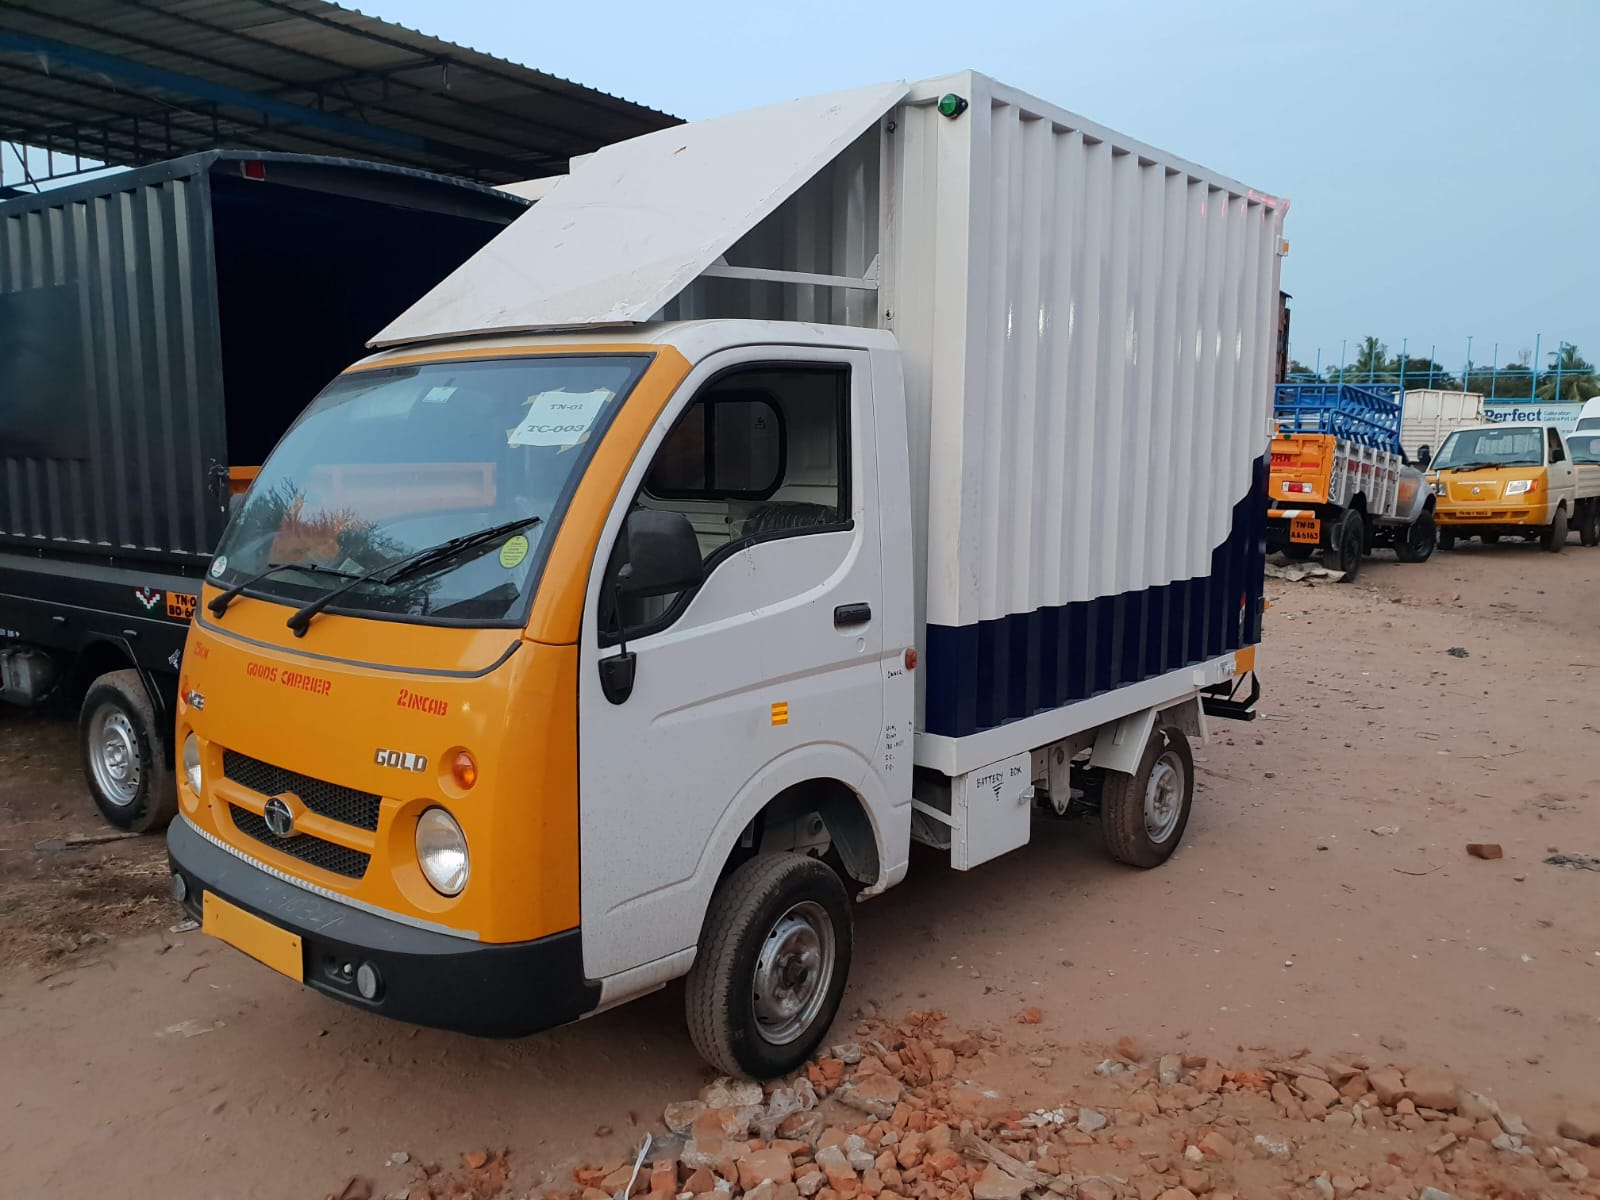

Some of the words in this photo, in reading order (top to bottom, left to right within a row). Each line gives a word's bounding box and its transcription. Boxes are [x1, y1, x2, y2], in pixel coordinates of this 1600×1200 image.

[550, 403, 583, 411] TN-01
[1483, 408, 1542, 422] Perfect
[527, 424, 585, 433] TC-003
[246, 661, 278, 683] GOODS
[280, 670, 332, 697] CARRIER
[375, 748, 428, 772] GOLD
